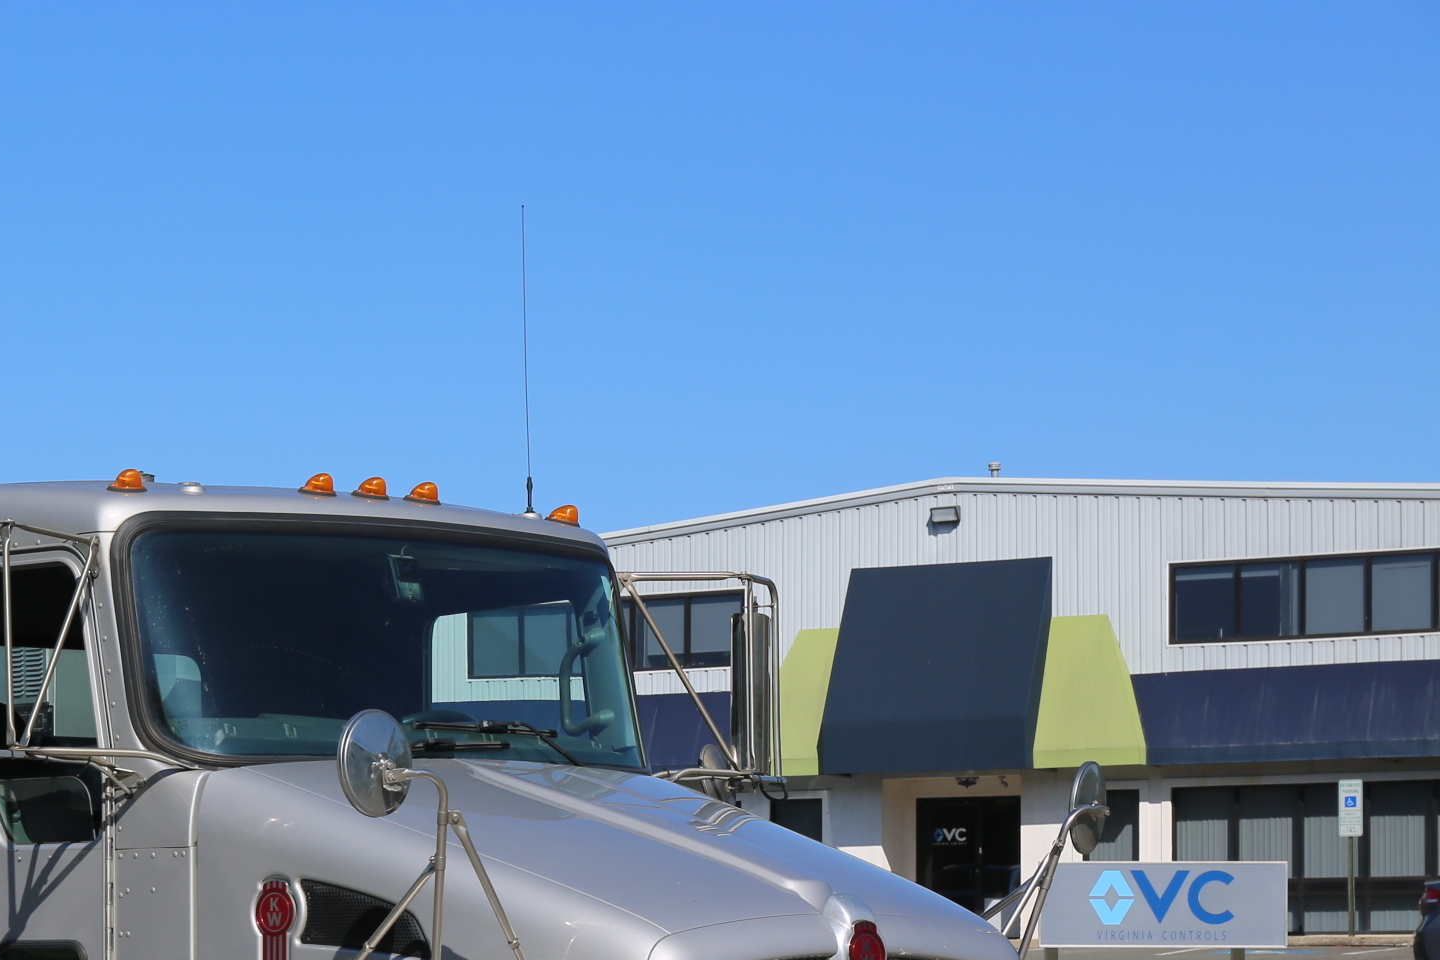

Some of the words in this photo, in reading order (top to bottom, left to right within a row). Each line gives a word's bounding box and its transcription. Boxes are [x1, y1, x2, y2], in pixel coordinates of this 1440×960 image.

[942, 828, 967, 841] VC
[1130, 870, 1235, 925] VC
[1097, 931, 1153, 940] VIRGINIA
[1162, 931, 1227, 940] CONTROLS
